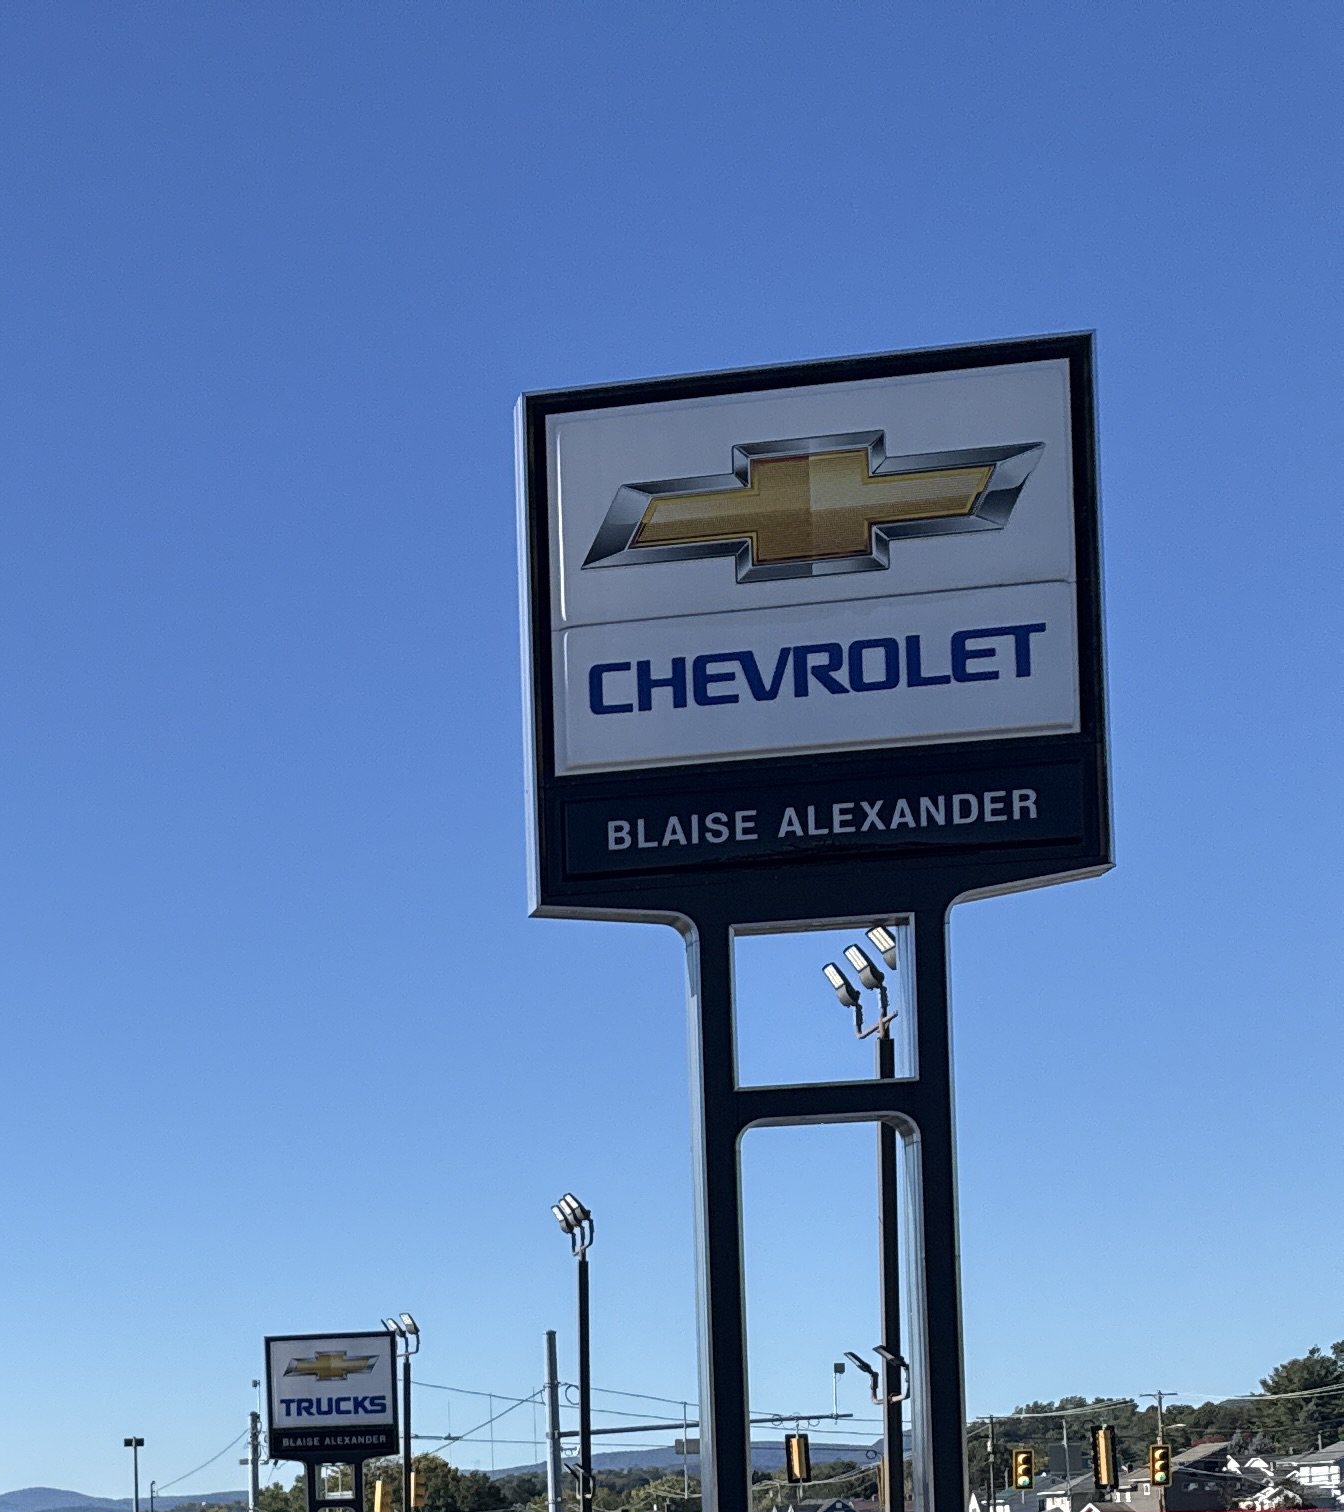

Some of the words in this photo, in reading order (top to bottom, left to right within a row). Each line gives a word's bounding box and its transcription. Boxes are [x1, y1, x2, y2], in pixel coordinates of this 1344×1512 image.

[589, 622, 1046, 715] CHEVROLET
[607, 810, 758, 850] BLAISE
[778, 788, 1037, 839] ALEXANDER
[280, 1395, 387, 1417] TRUCKS
[282, 1437, 320, 1447] BLAISE
[324, 1434, 386, 1445] ALEXANDER
